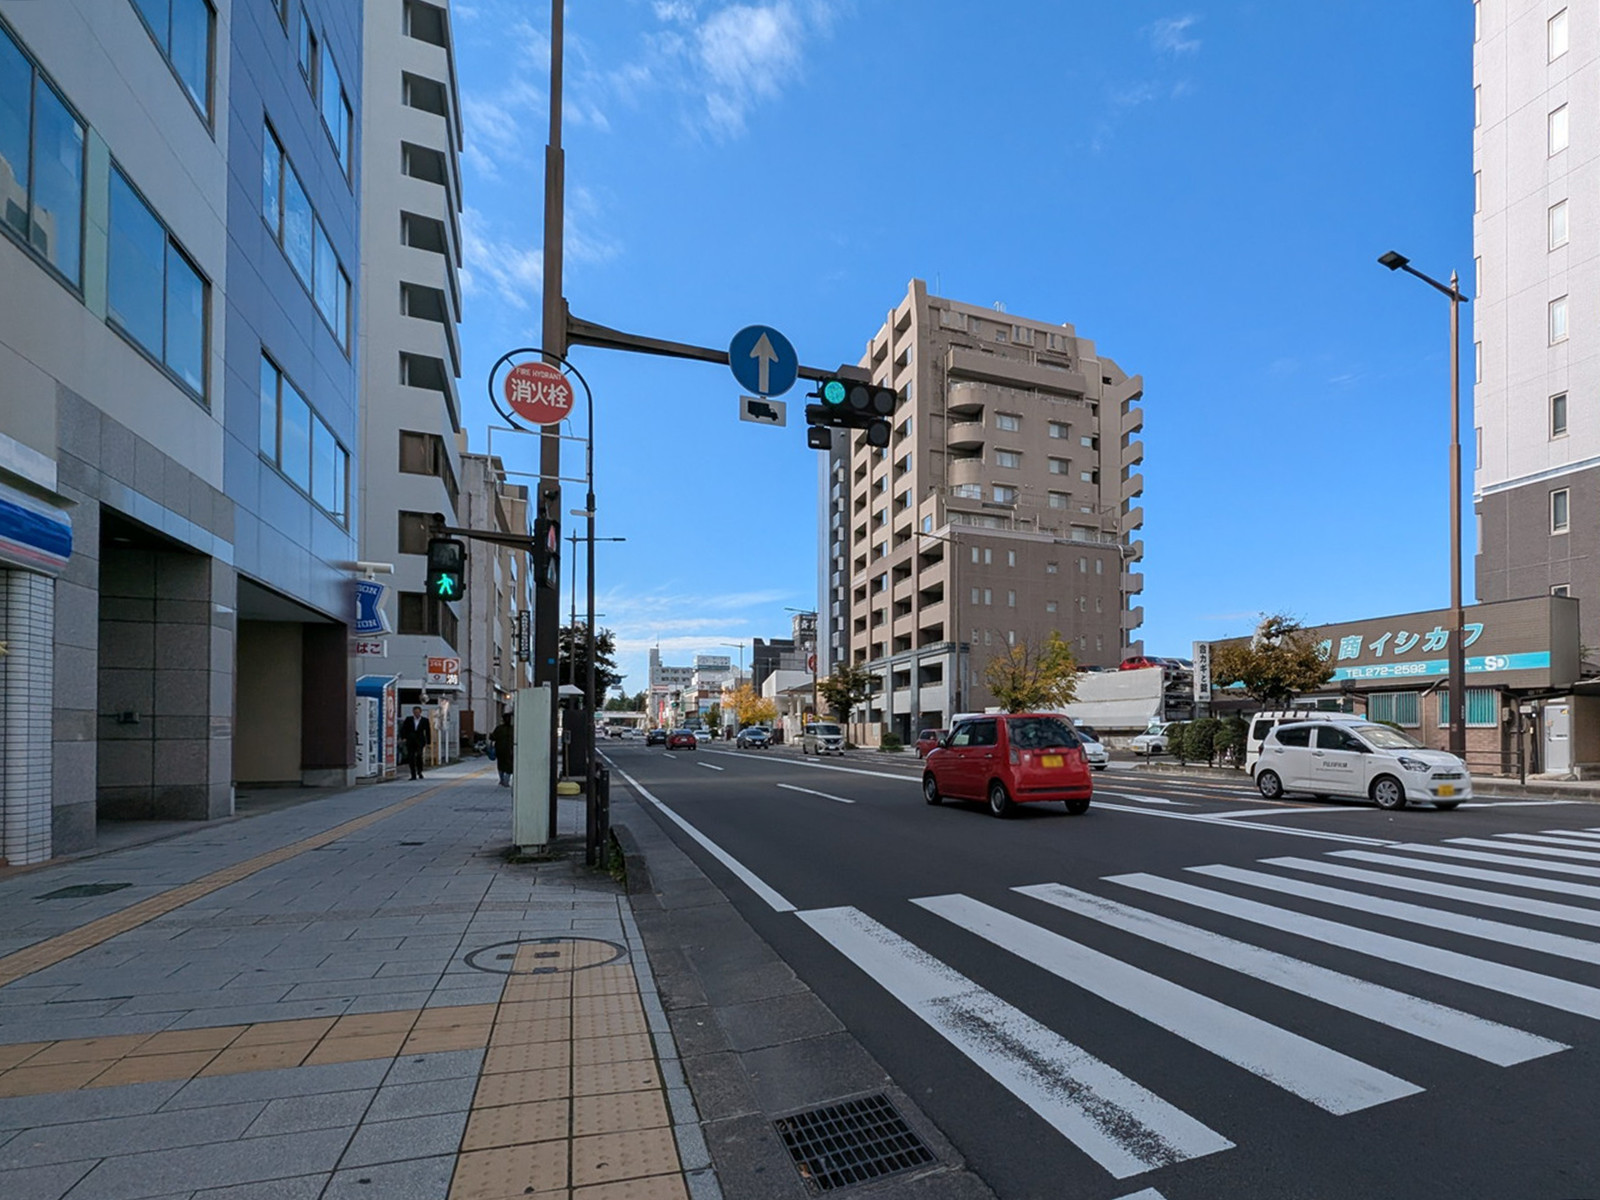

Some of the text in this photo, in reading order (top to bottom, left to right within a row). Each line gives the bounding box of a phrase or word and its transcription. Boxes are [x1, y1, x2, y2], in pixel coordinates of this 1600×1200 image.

[516, 367, 562, 380] FIRE HYDRANT
[511, 378, 568, 408] 消火栓
